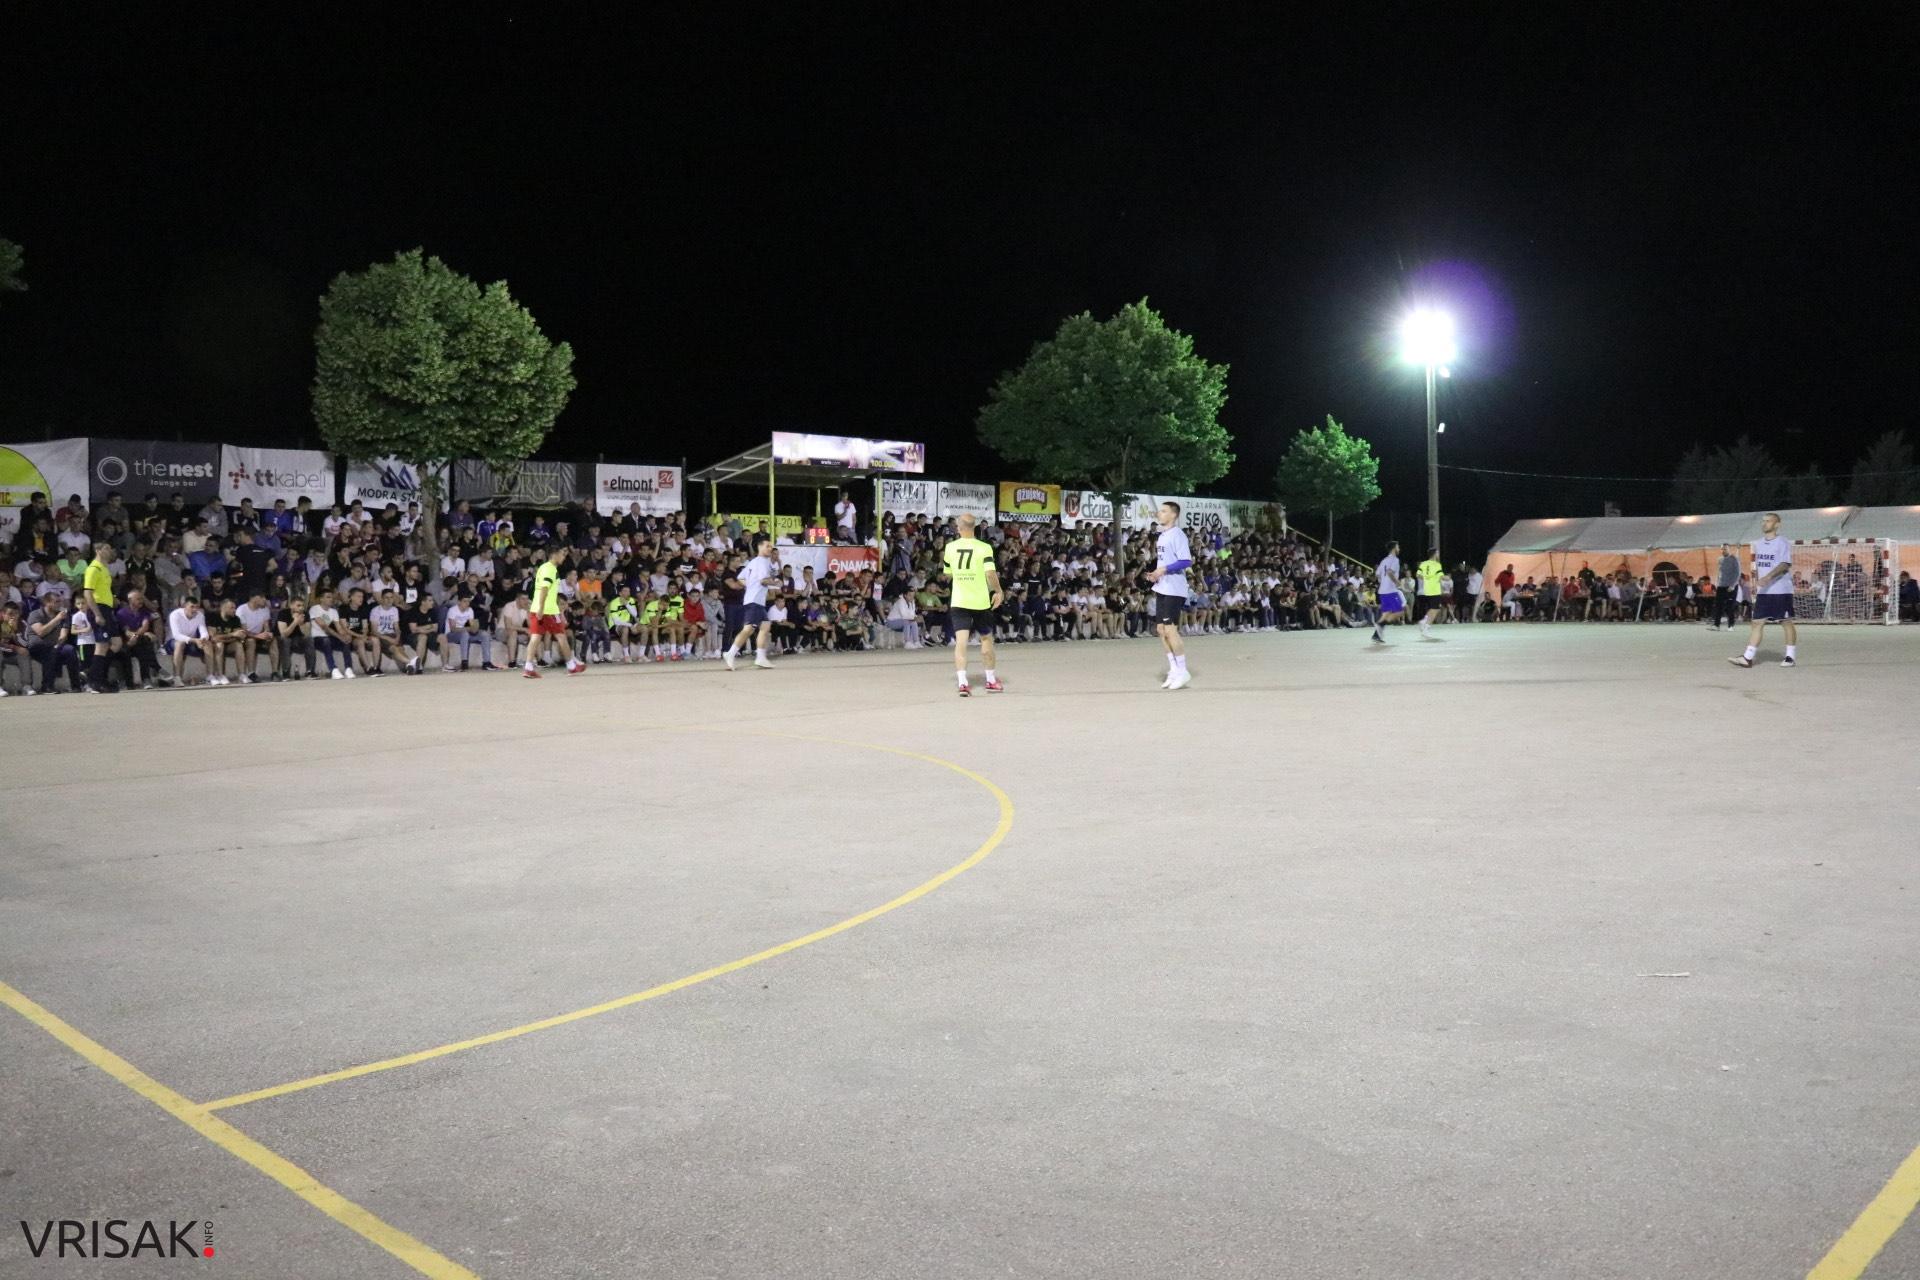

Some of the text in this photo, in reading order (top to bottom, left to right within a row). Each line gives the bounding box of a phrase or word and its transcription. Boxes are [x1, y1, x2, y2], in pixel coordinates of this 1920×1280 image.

[169, 462, 213, 477] nest
[610, 475, 654, 492] elmont
[357, 487, 397, 501] MODRA
[957, 549, 973, 569] 77
